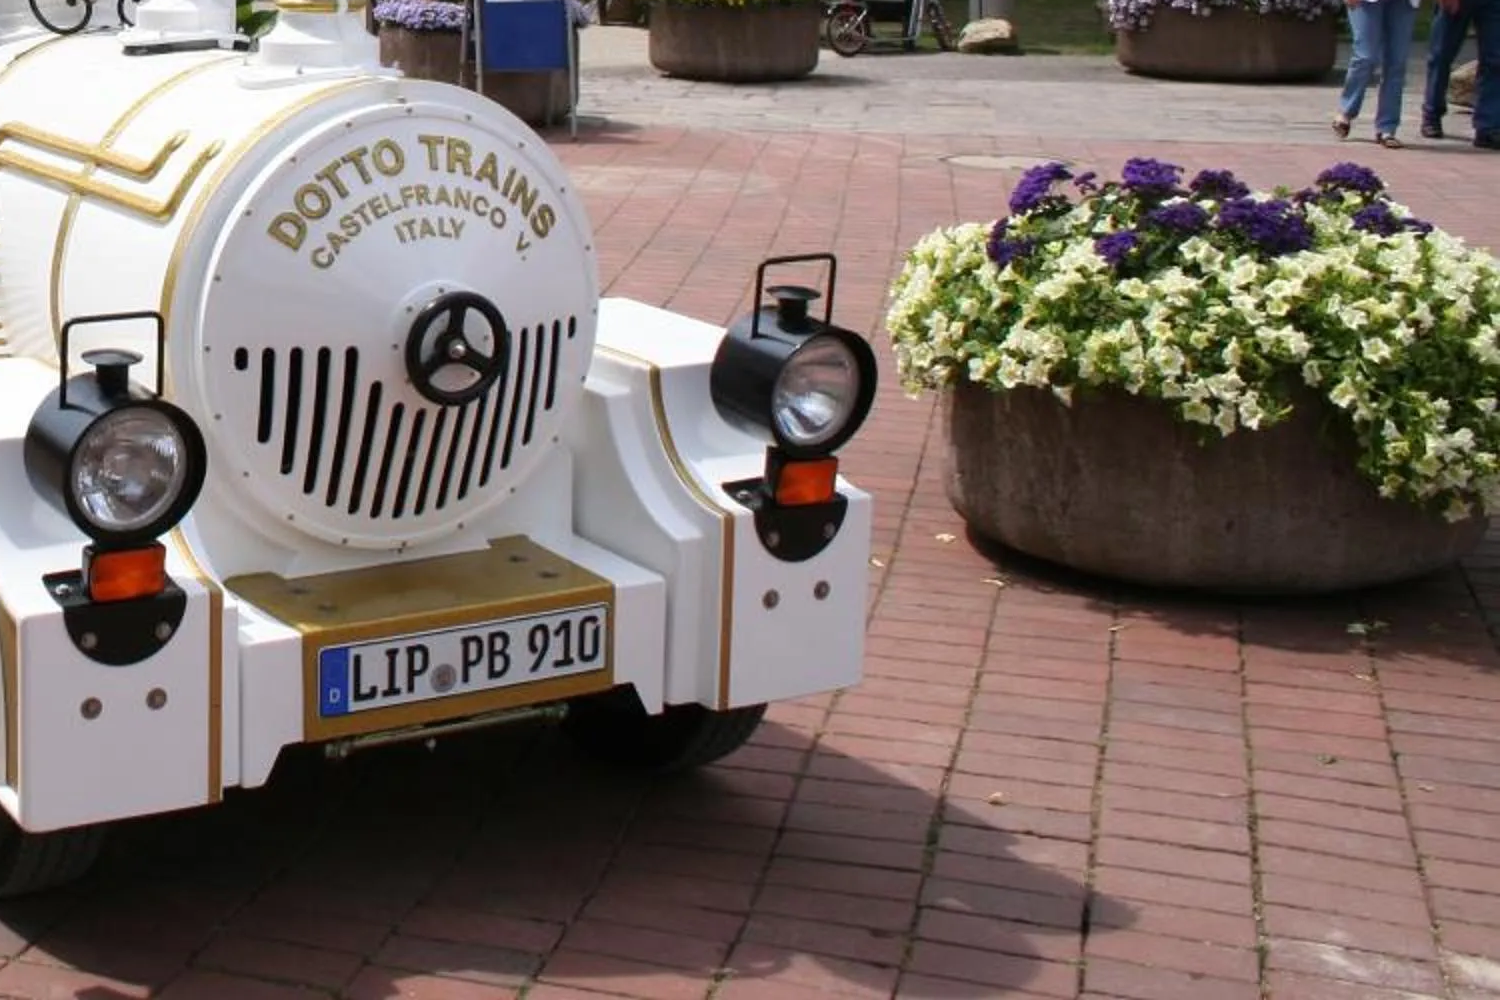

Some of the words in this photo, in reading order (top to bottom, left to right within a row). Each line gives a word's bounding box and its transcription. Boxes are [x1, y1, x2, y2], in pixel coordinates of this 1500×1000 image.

[267, 137, 405, 252] DOTTO
[417, 134, 557, 240] TRAINS
[310, 183, 507, 269] CASTELFRANCO
[393, 217, 467, 244] ITALY
[353, 643, 430, 702] LIP
[460, 630, 511, 683] PB
[528, 615, 600, 673] 910
